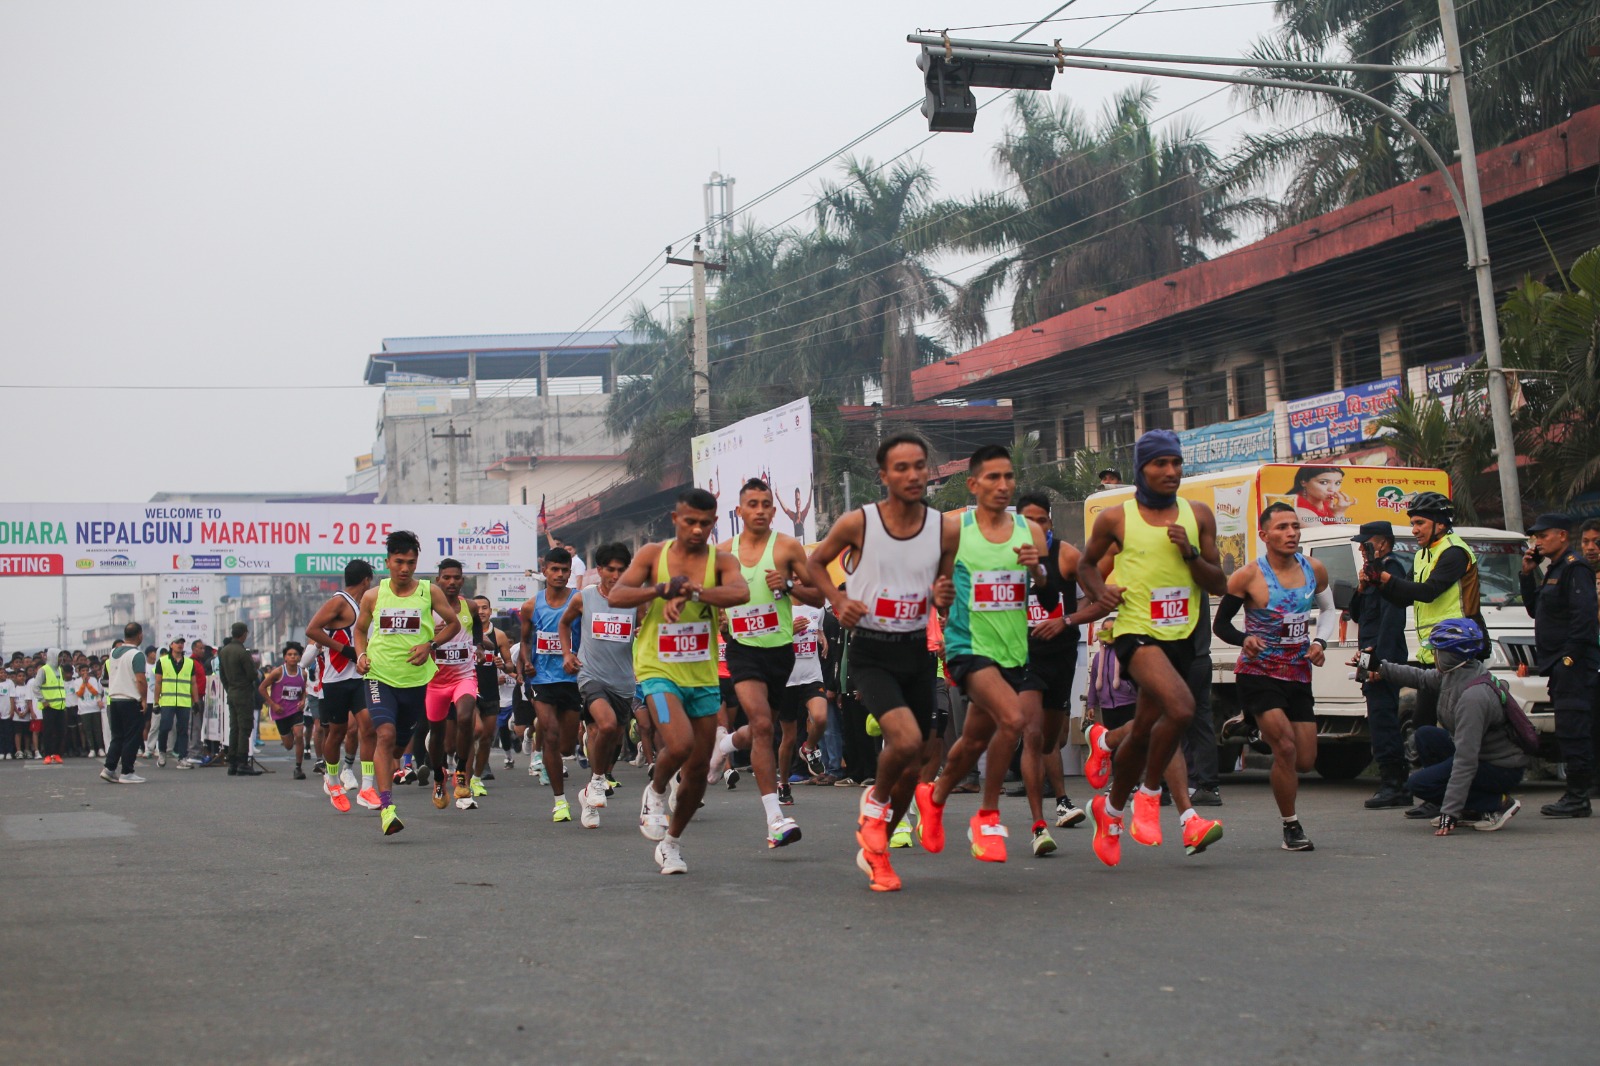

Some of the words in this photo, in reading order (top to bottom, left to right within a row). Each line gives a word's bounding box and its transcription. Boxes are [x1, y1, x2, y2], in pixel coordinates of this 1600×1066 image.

[145, 508, 203, 519] WELCOME
[207, 508, 221, 519] TO
[0, 521, 68, 545] DHARA
[76, 521, 192, 545] NEPALGUNJ
[201, 521, 309, 545] MARATHON
[458, 535, 510, 544] NEPALGUNJ
[437, 537, 453, 556] 11
[991, 585, 1015, 601] 106
[894, 602, 919, 618] 130
[1161, 600, 1183, 618] 102
[391, 617, 408, 628] 187
[603, 623, 621, 634] 108
[744, 616, 765, 631] 128
[1287, 623, 1305, 637] 189
[546, 640, 561, 650] 129
[674, 636, 697, 651] 109
[797, 643, 811, 652] 154
[445, 650, 460, 659] 190
